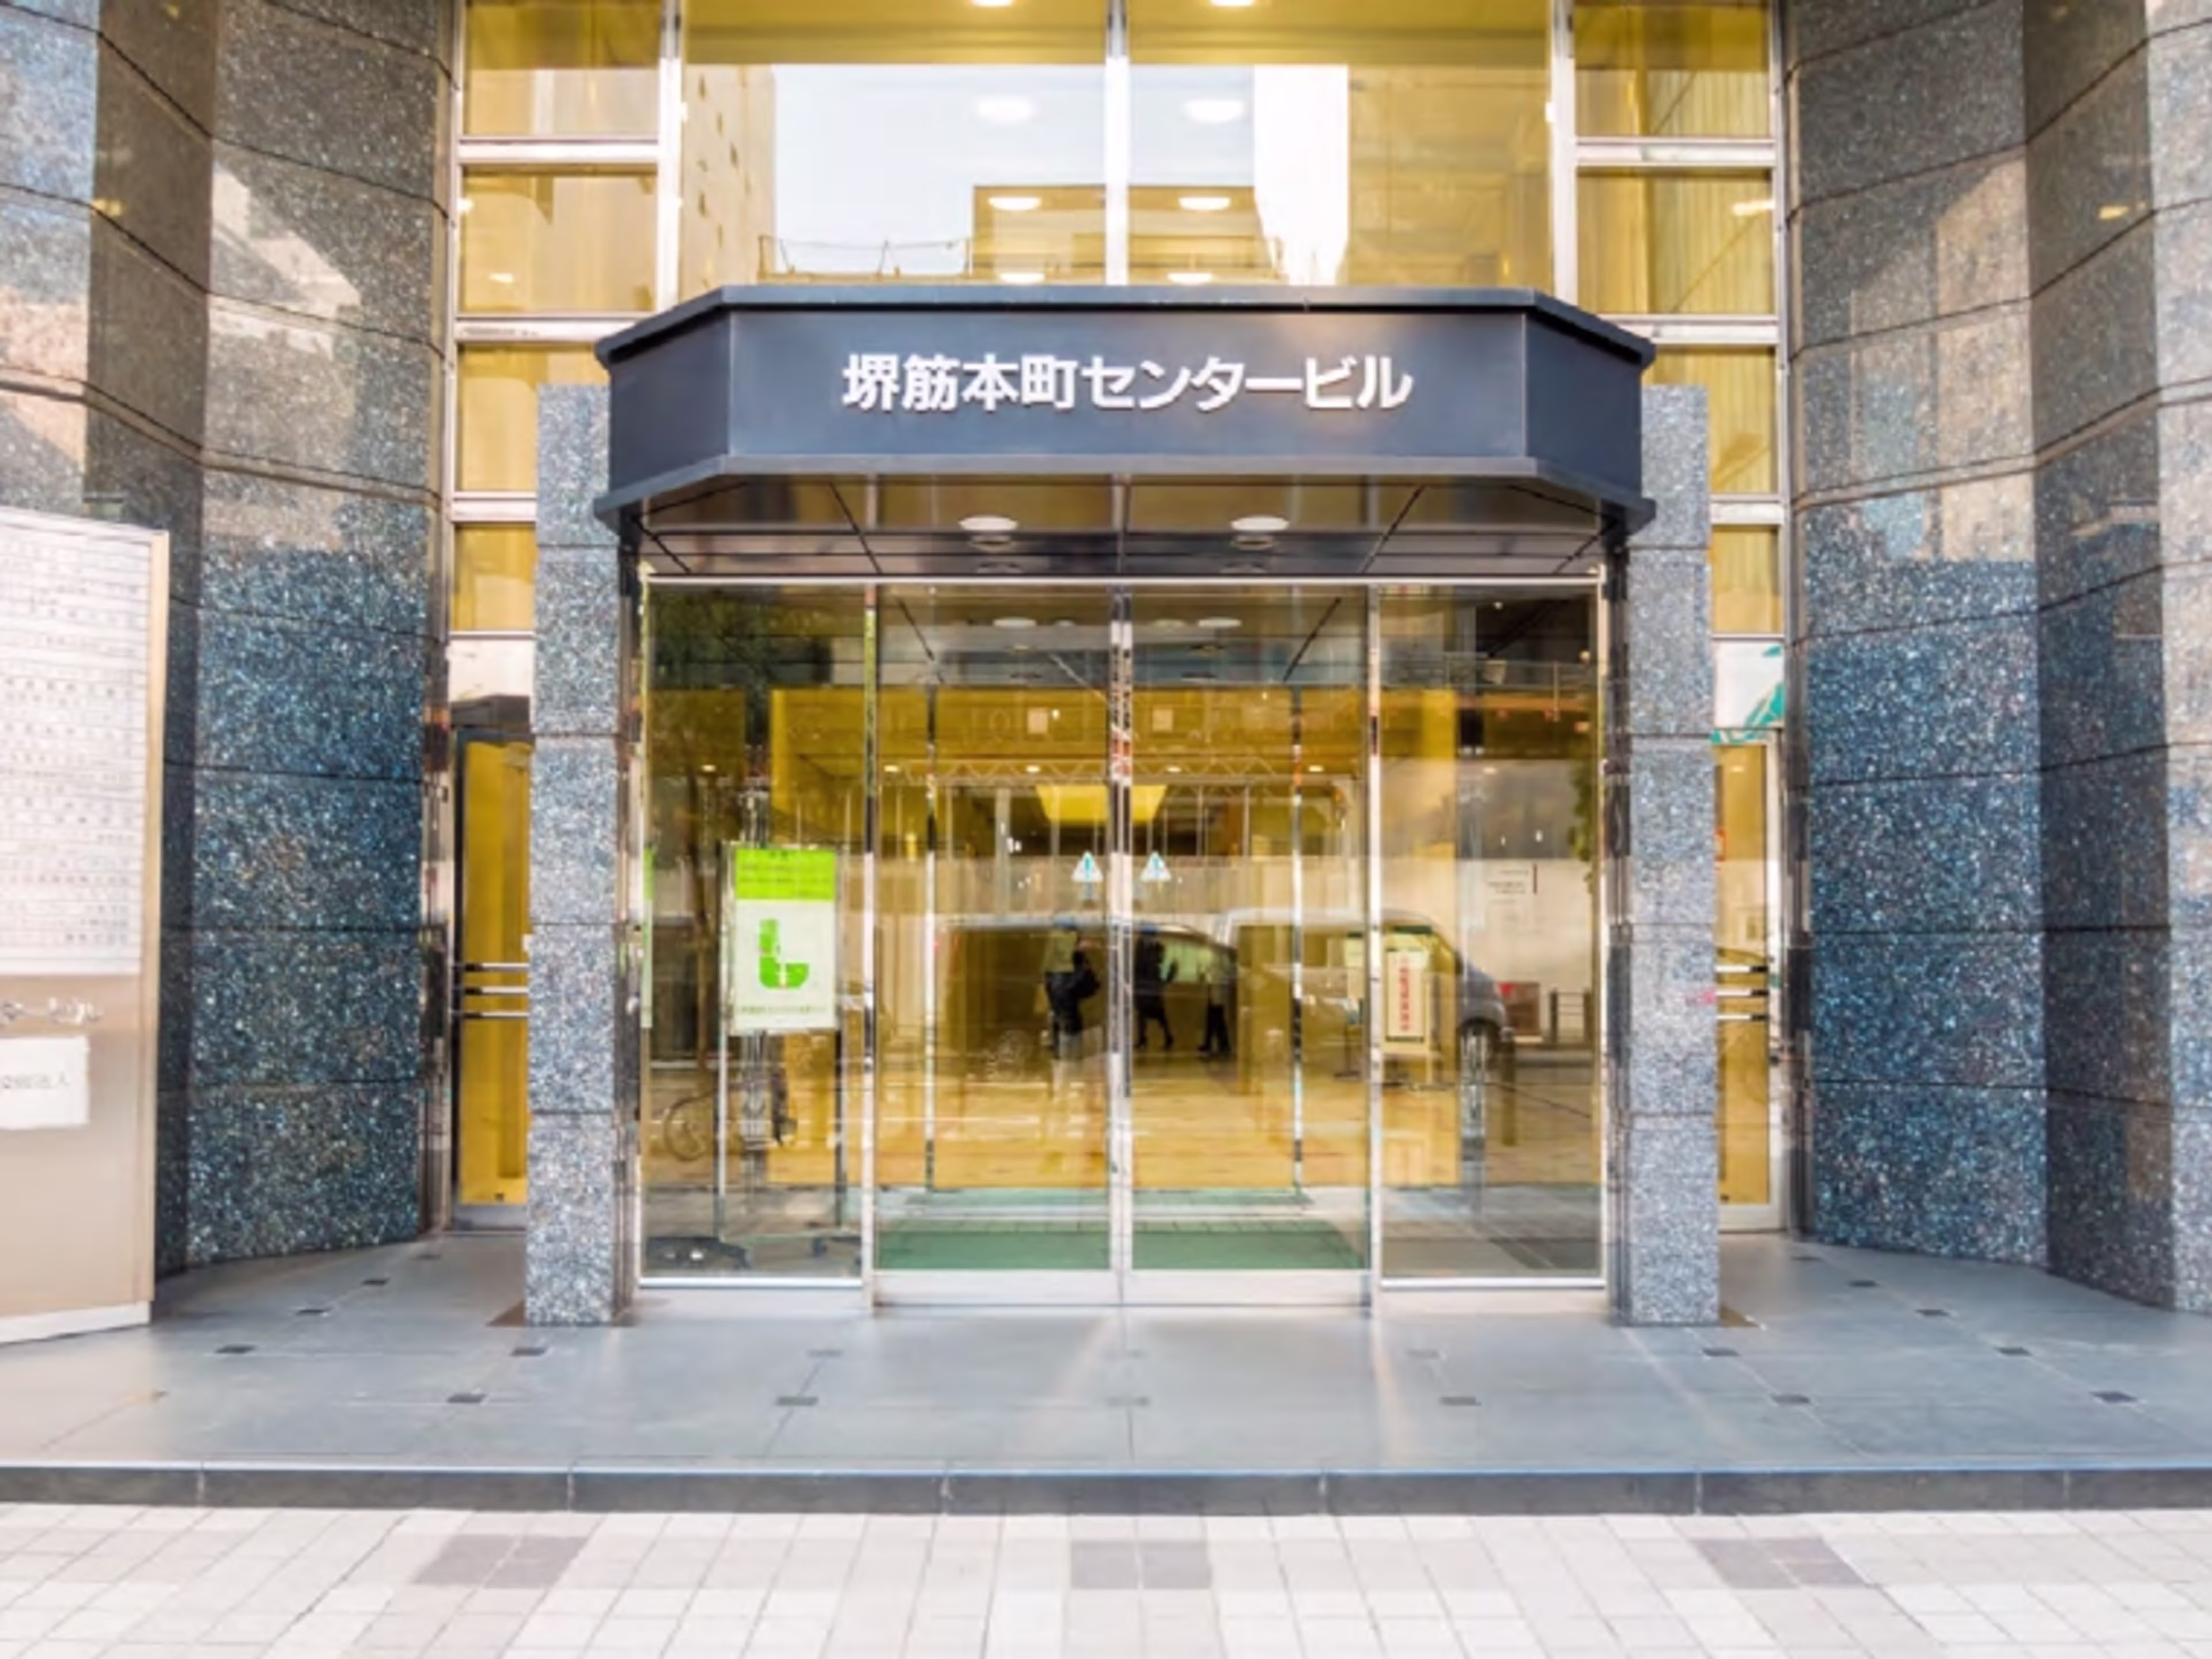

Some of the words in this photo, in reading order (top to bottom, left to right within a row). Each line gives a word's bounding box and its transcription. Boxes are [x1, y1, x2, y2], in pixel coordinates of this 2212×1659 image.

[842, 353, 1413, 411] 堺筋本町センタービル
